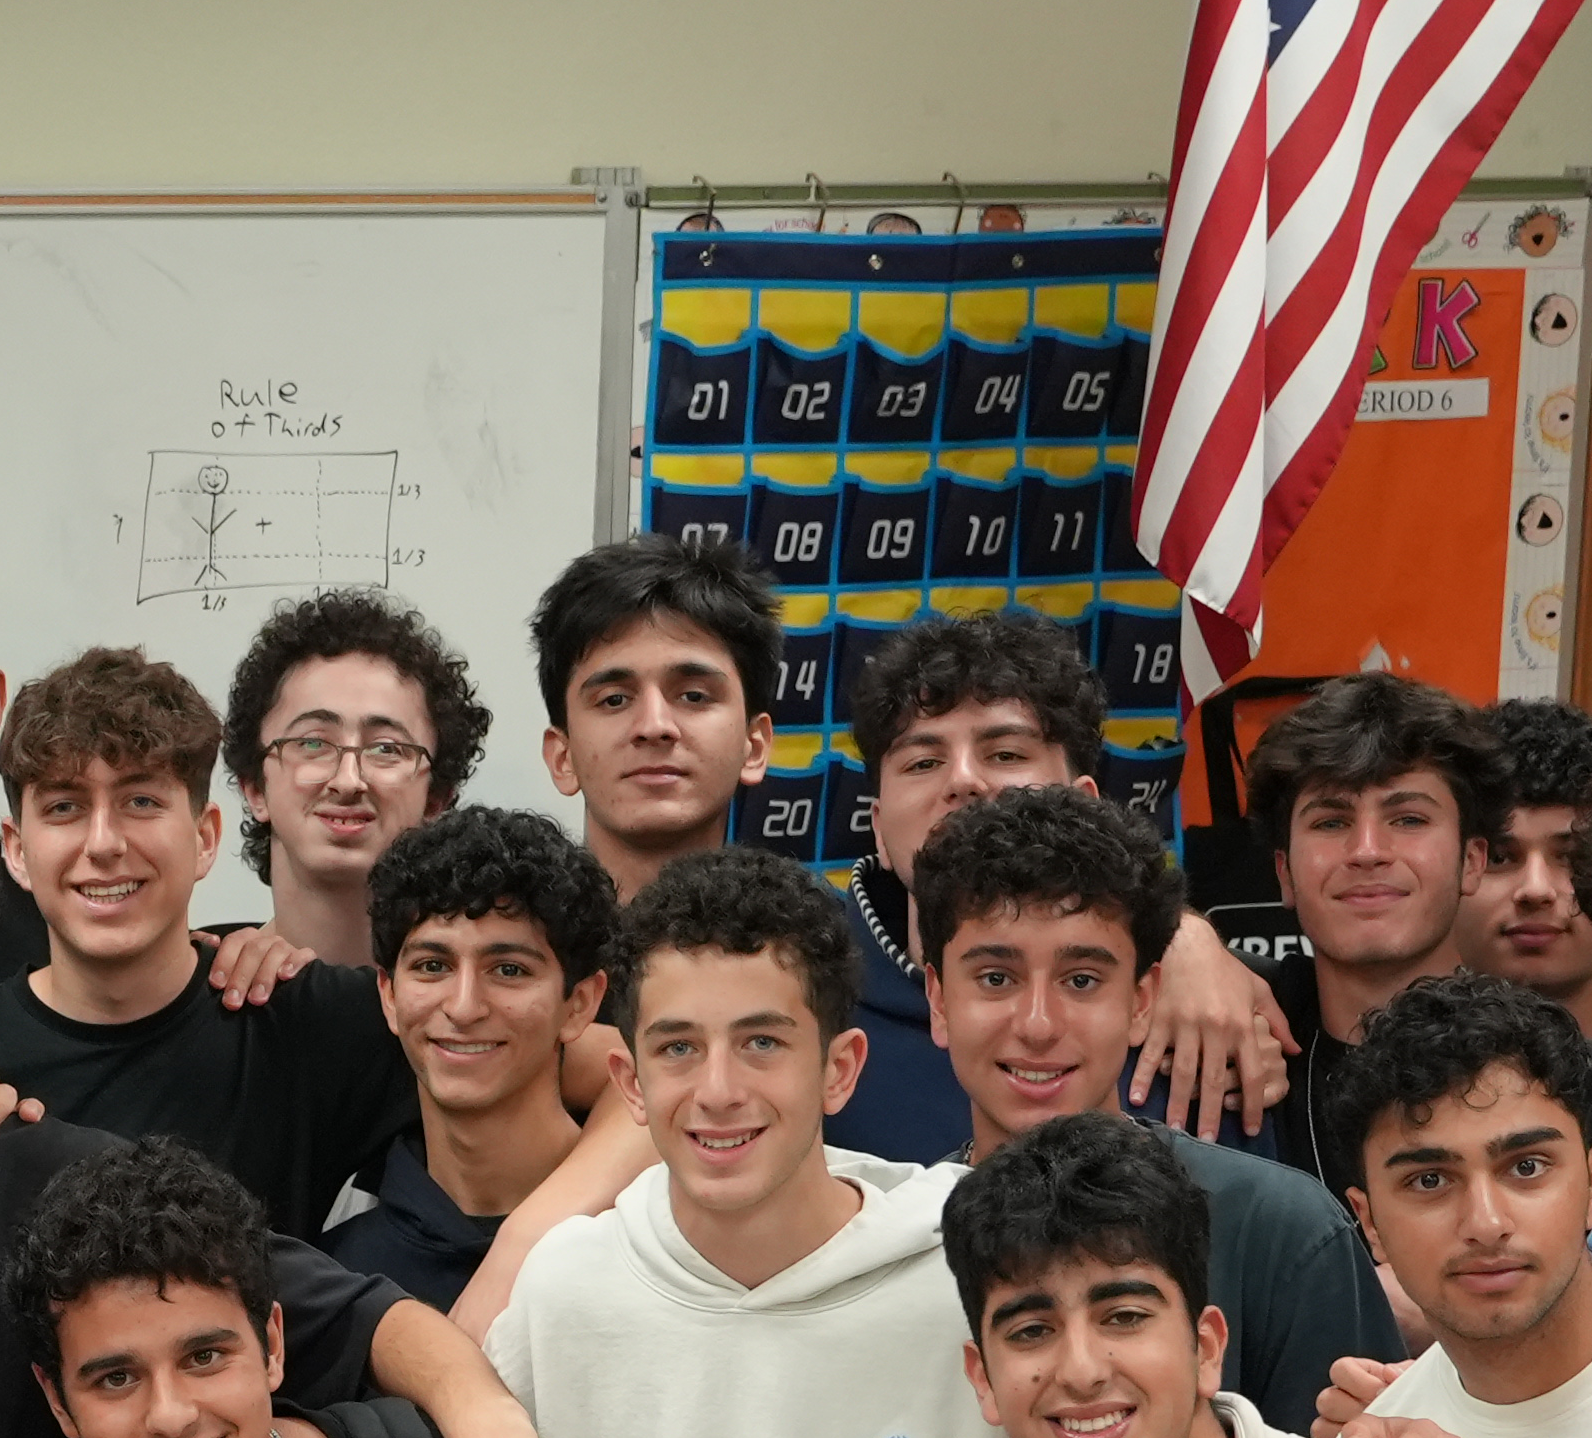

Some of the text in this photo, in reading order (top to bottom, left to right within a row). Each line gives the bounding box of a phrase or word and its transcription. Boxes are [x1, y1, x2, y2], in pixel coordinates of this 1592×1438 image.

[220, 379, 297, 409] Rule
[688, 381, 730, 420] 01
[781, 382, 830, 421] 02
[877, 383, 926, 418] 03
[975, 375, 1021, 414] 04
[1063, 371, 1109, 411] 05
[1357, 389, 1453, 414] ERIOD 6
[264, 412, 342, 437] Thirds
[774, 522, 823, 562] 08
[867, 519, 915, 559] 09
[965, 516, 1006, 555] 10
[1050, 512, 1083, 551] 11
[392, 547, 425, 567] 1/3
[775, 660, 816, 700] 14
[1133, 643, 1173, 683] 18
[762, 799, 812, 837] 20
[850, 795, 879, 832] 2
